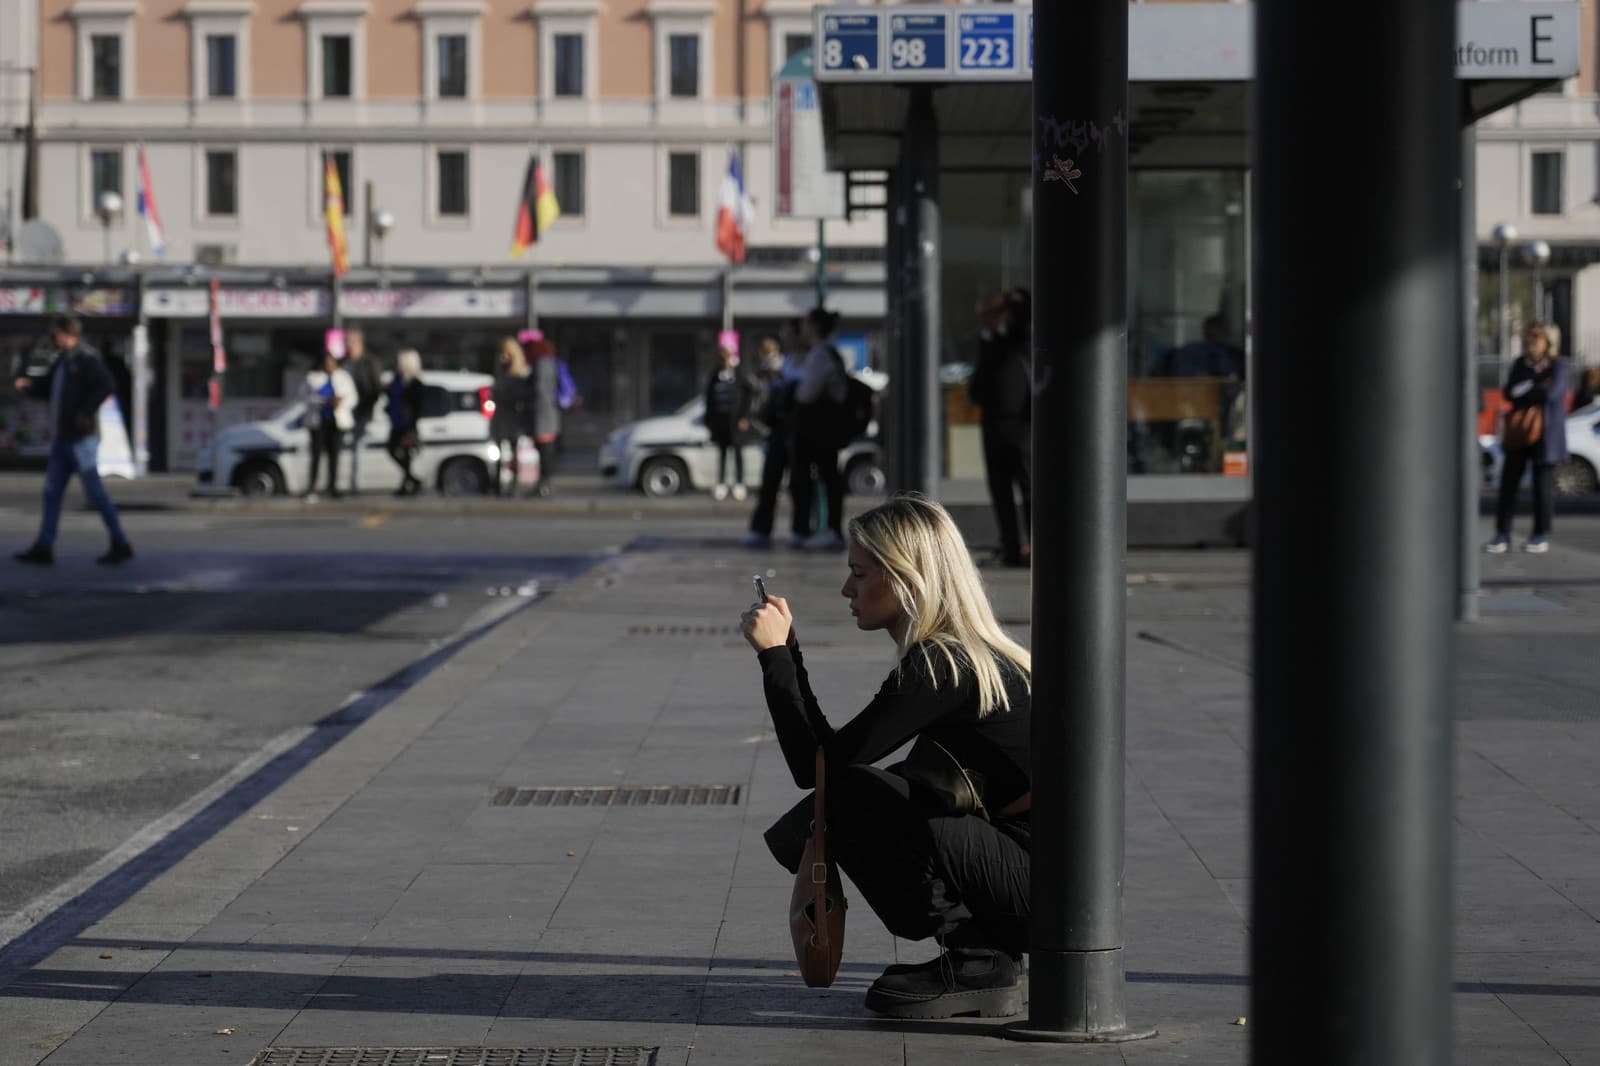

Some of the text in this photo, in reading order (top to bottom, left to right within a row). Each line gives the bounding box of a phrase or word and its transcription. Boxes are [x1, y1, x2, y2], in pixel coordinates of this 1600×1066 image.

[825, 38, 843, 68] 8
[892, 38, 926, 68] 98
[961, 38, 1010, 67] 223
[1456, 14, 1554, 66] tform E
